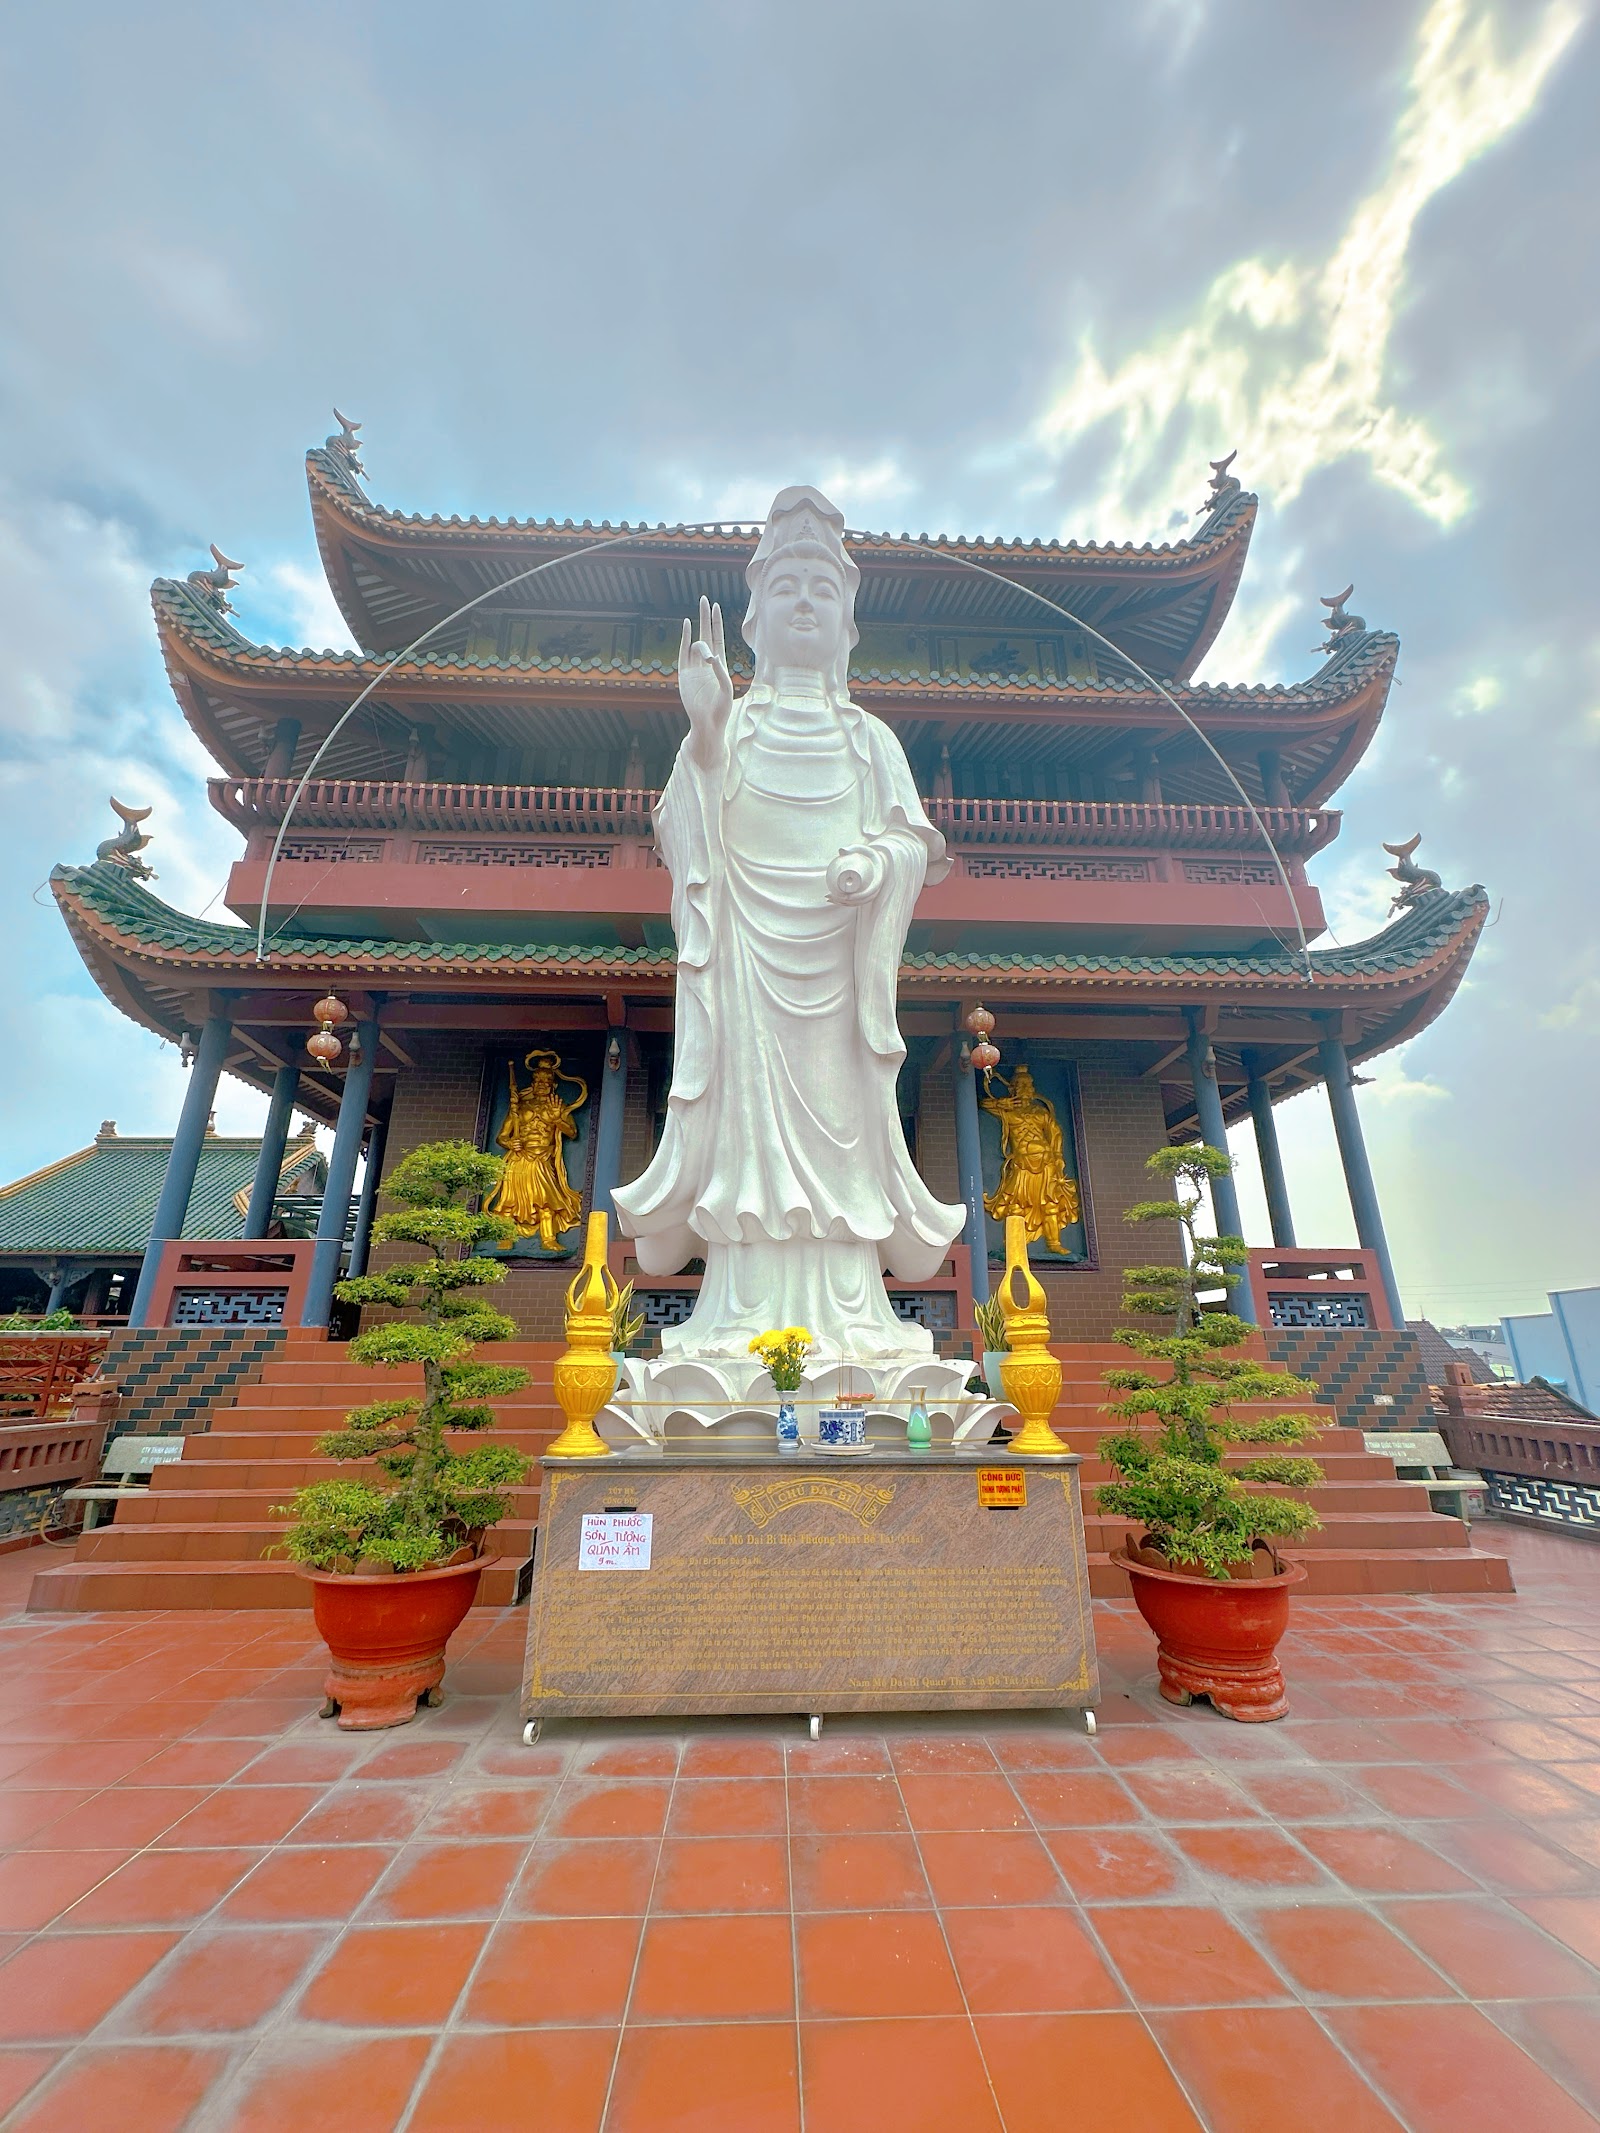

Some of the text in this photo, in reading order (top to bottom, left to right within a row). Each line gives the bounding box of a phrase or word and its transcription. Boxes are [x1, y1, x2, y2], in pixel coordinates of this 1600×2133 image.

[982, 1471, 1021, 1481] CÔNG ĐỨC
[778, 1484, 805, 1502] CHÚ
[838, 1491, 852, 1502] BI
[587, 1516, 607, 1526] HÙN
[585, 1530, 606, 1540] SƠN
[704, 1534, 726, 1545] Nam
[766, 1533, 777, 1544] Bi
